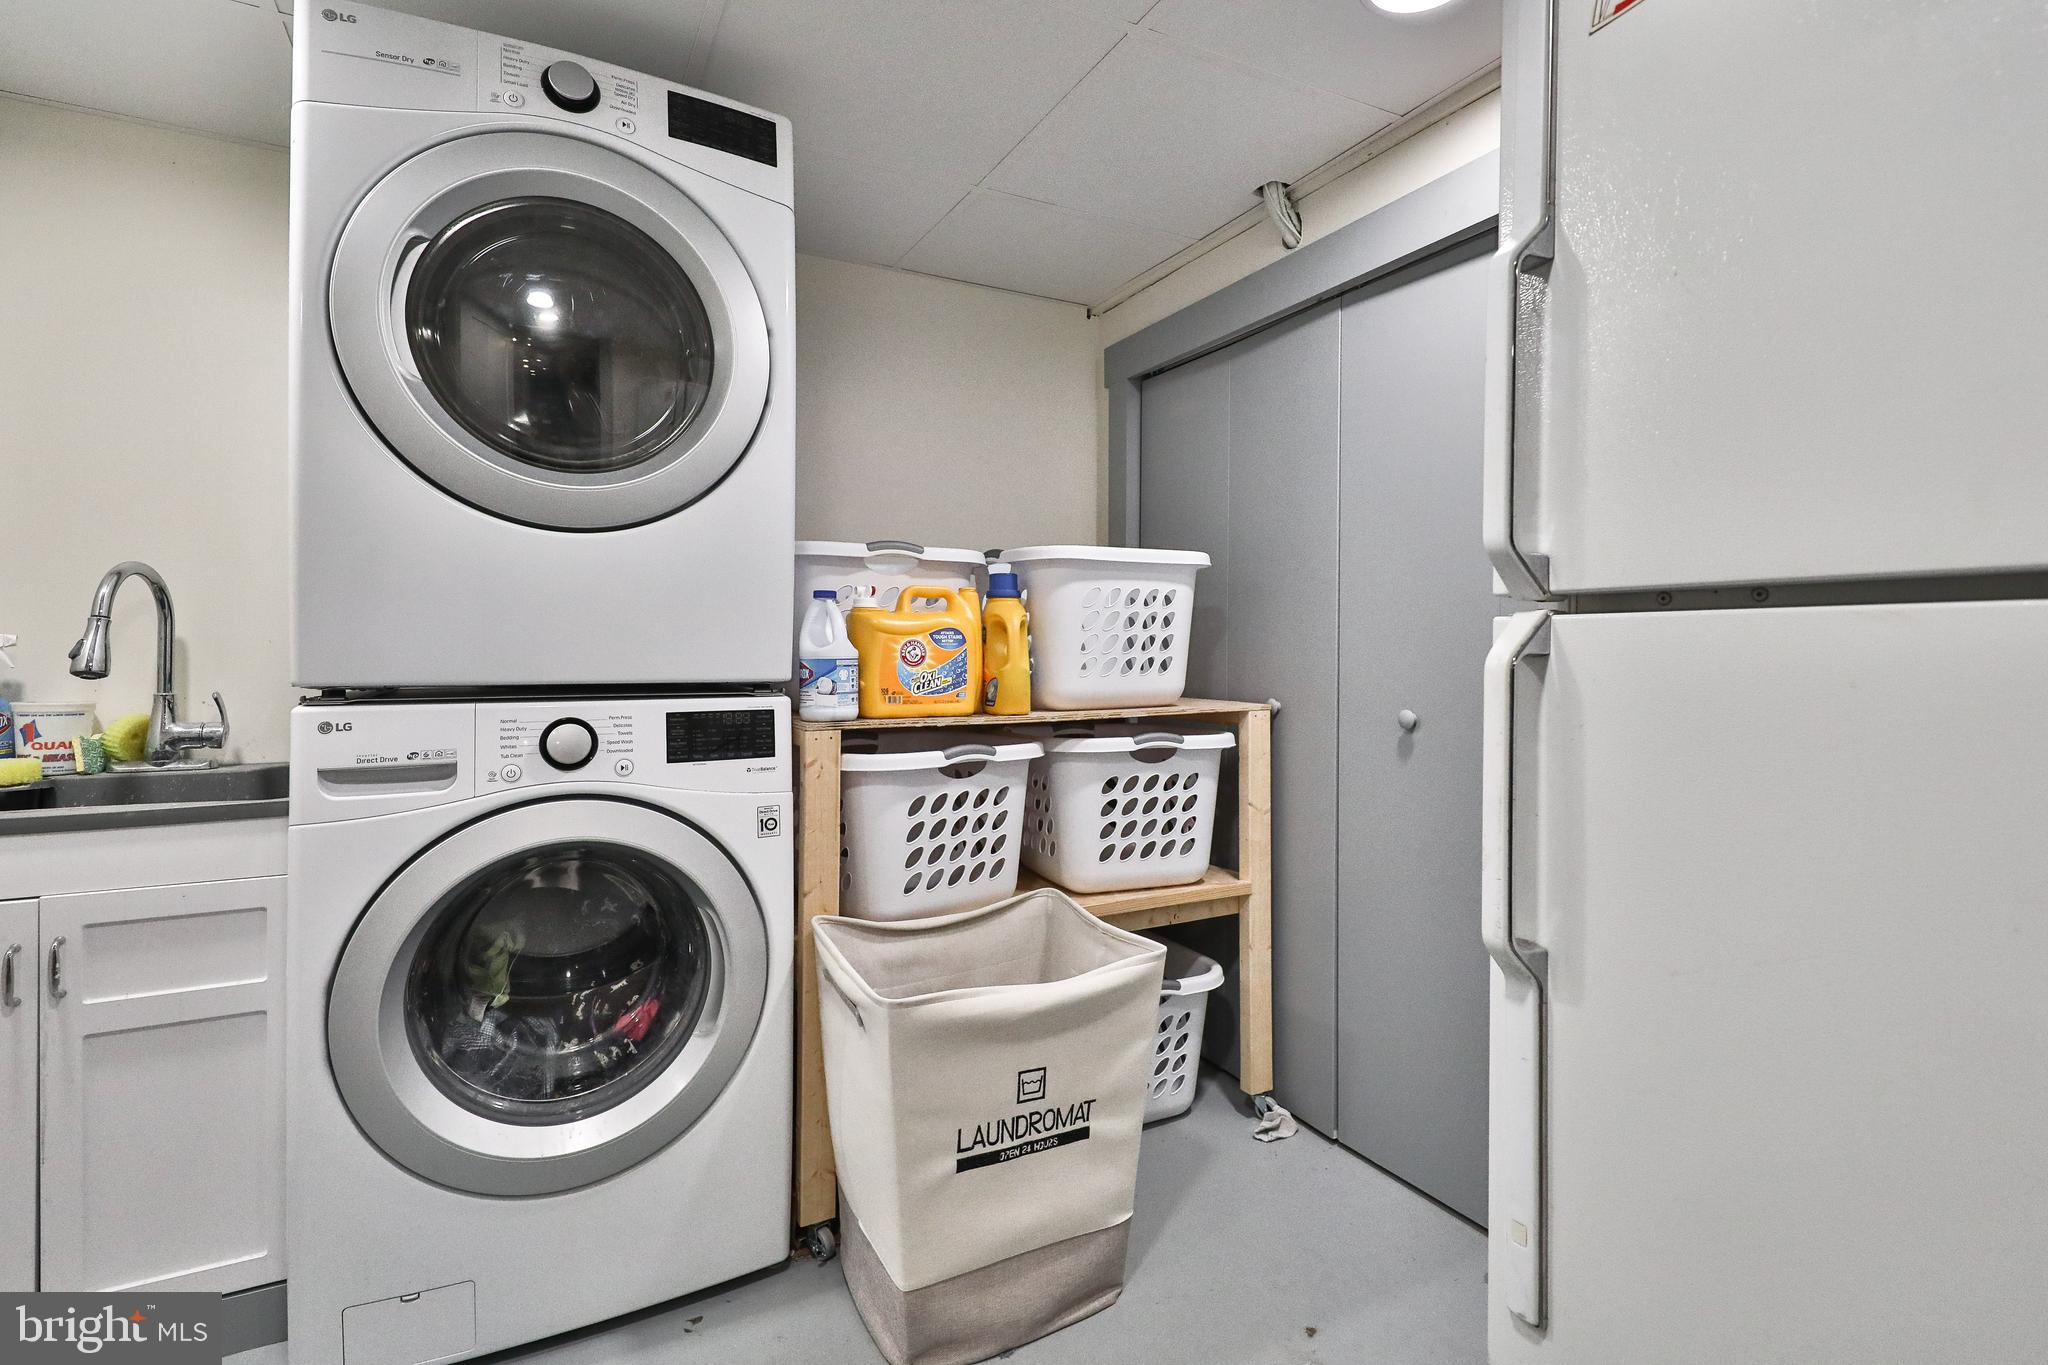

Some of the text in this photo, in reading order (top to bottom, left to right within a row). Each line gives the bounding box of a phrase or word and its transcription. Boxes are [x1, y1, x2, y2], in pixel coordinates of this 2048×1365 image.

[340, 13, 357, 24] LG
[375, 51, 415, 64] Sensor Dry
[920, 670, 936, 683] OXI
[913, 677, 941, 694] CLEAN
[335, 722, 353, 732] LG
[760, 817, 778, 832] 10
[957, 1099, 1096, 1153] LAUNDROMAT
[1000, 1137, 1058, 1160] OPEN 24 HOURS
